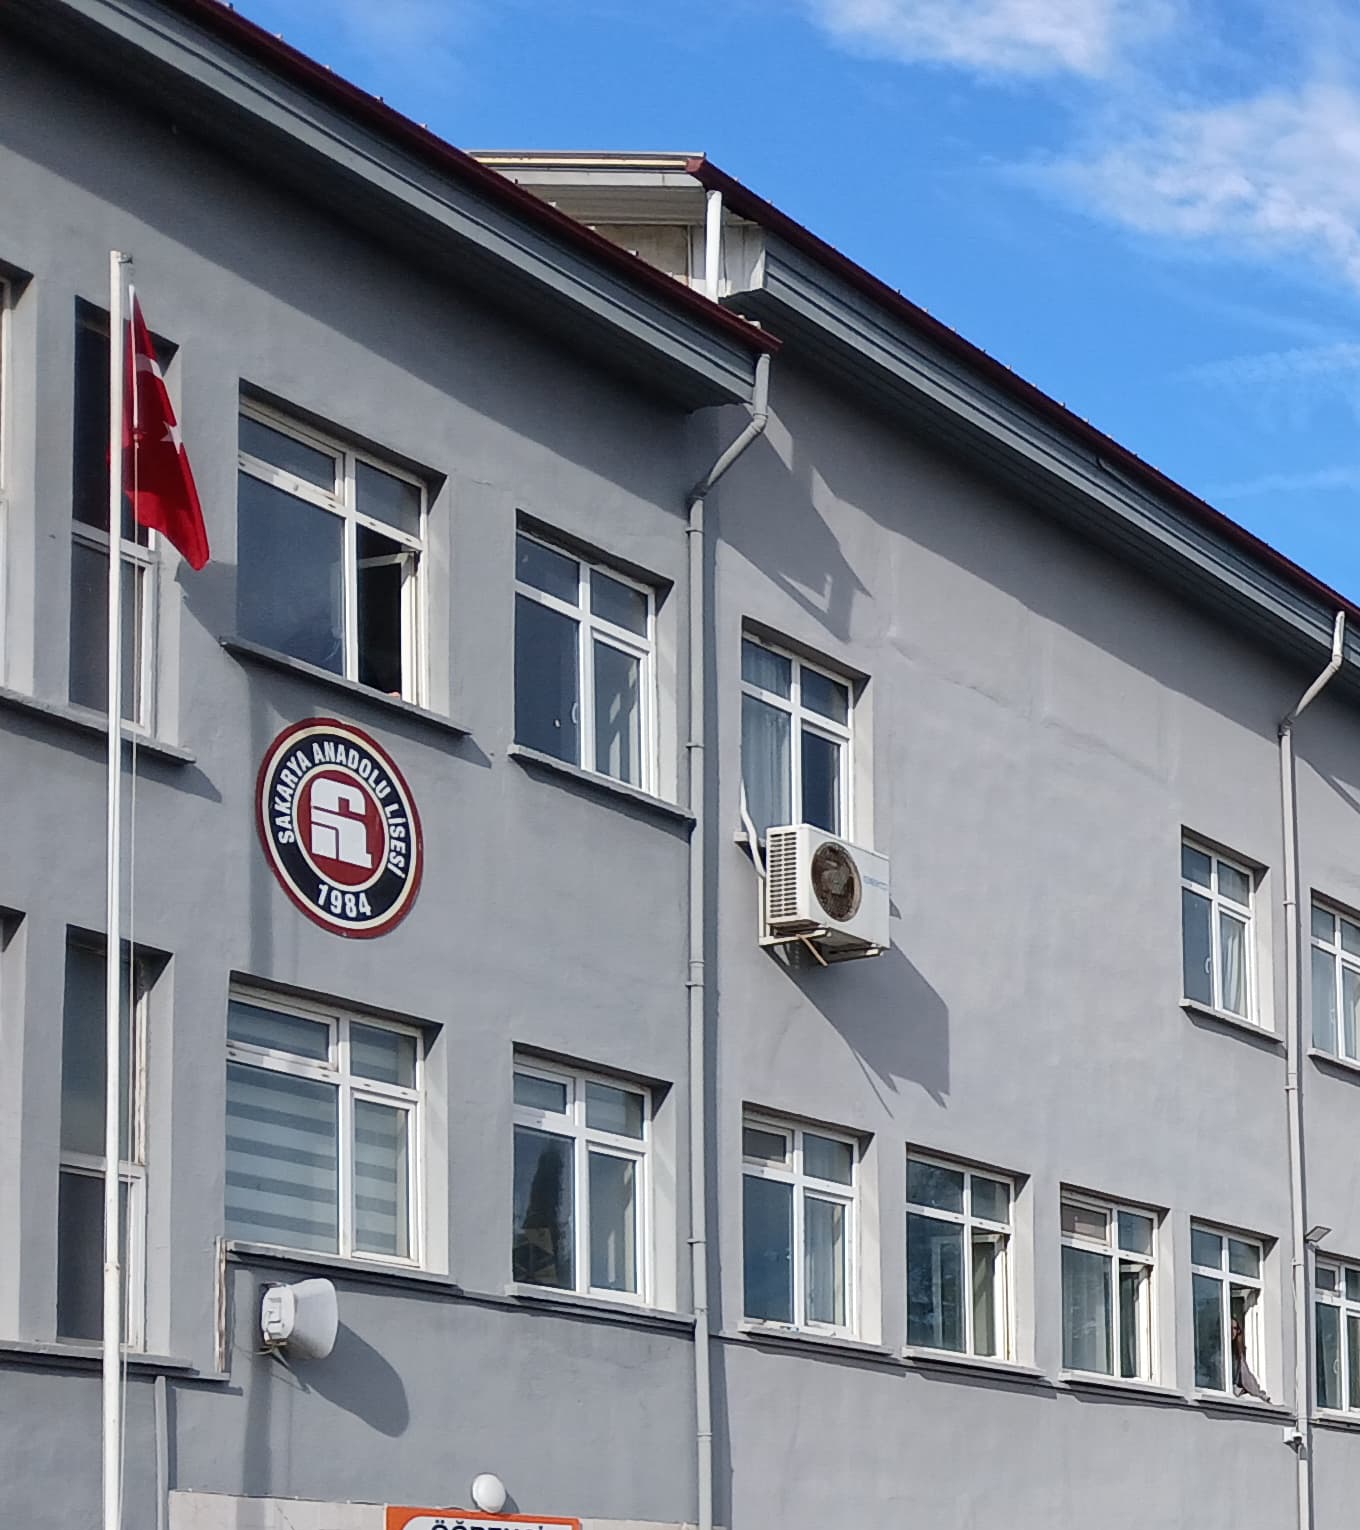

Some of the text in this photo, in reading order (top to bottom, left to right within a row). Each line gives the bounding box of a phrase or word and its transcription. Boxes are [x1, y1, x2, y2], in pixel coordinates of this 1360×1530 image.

[274, 750, 312, 845] SAKARYA
[312, 741, 391, 799] ANADOLU
[317, 883, 372, 918] 1984
